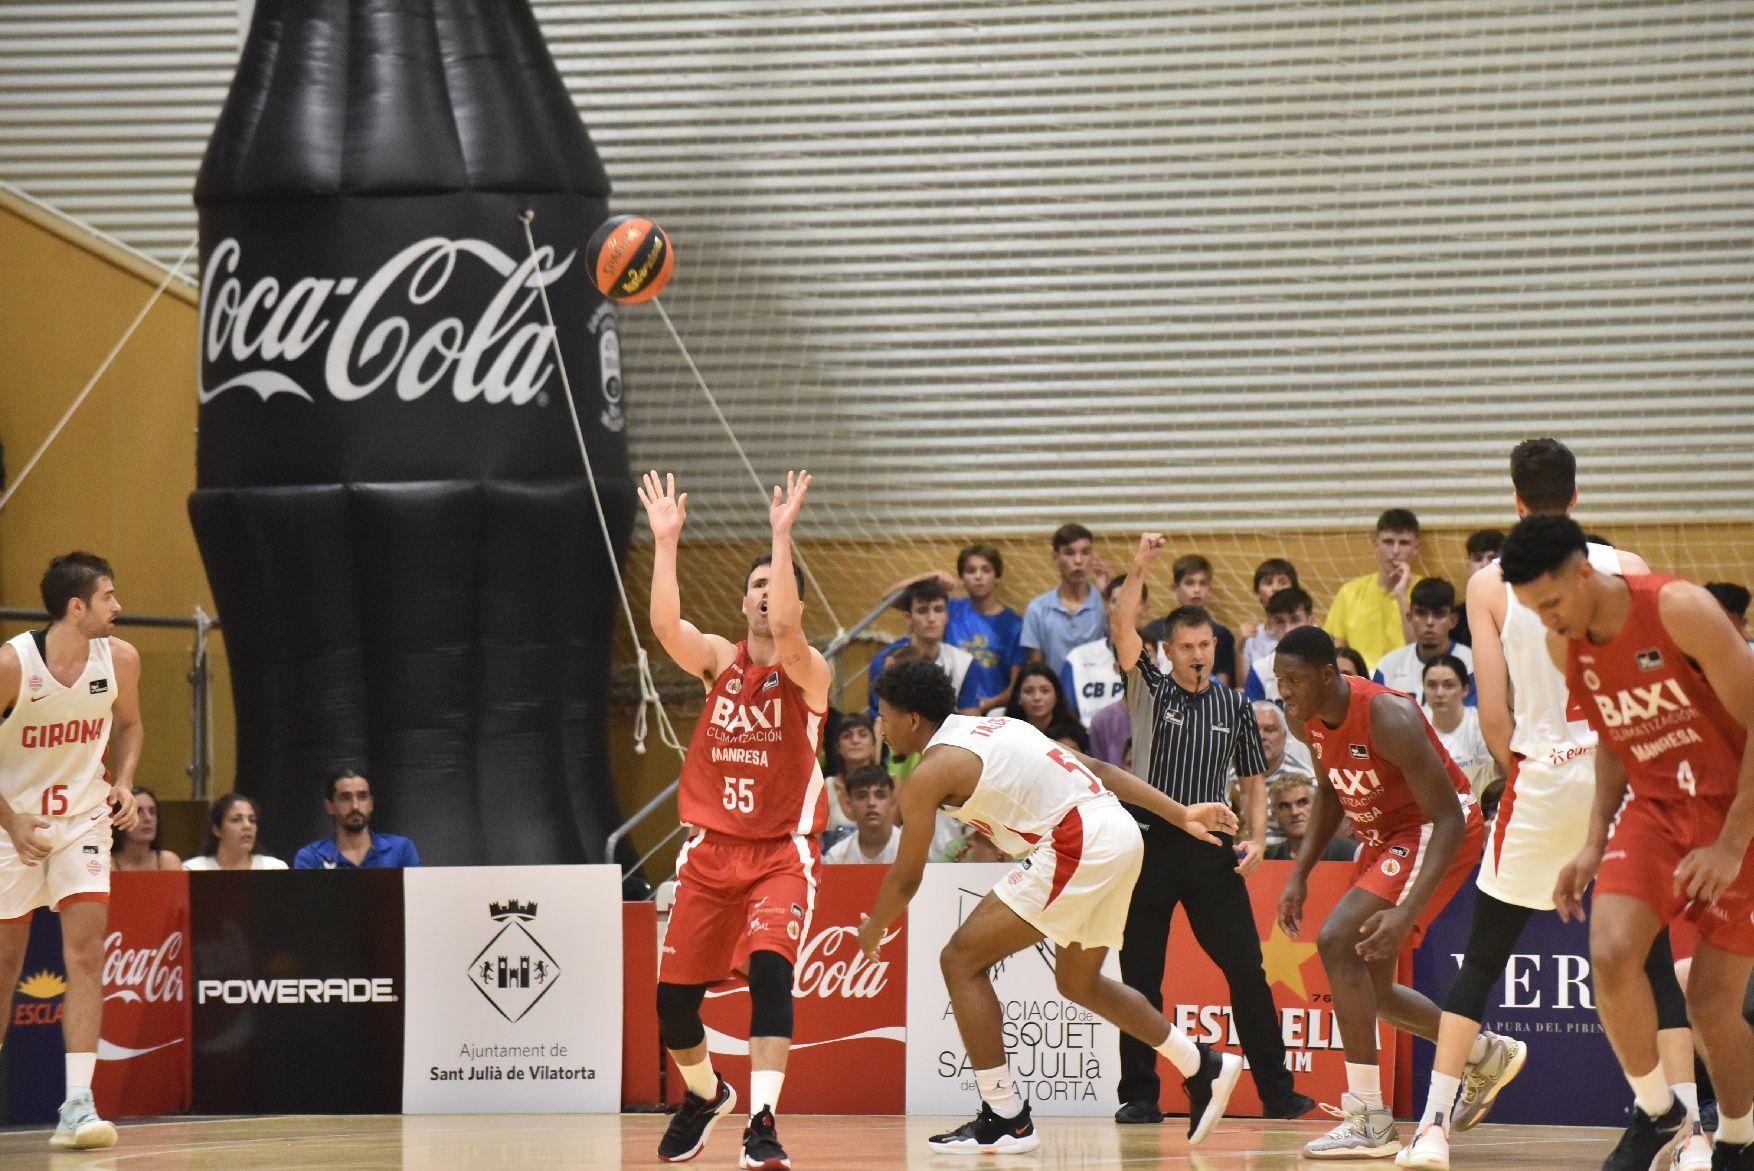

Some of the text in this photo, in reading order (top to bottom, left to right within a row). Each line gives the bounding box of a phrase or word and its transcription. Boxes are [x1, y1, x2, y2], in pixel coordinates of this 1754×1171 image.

[199, 236, 577, 406] Coca-Cola
[1082, 682, 1105, 698] CB
[1593, 678, 1691, 727] BAXI
[710, 695, 782, 733] BAXI
[21, 717, 104, 749] GIRONA
[706, 726, 783, 744] CLIMATIZACIÓN
[1630, 727, 1703, 763] MANRESA
[711, 747, 769, 768] MANRESA
[1328, 767, 1381, 796] AXI
[1677, 760, 1697, 797] 4
[41, 784, 68, 816] 15
[722, 776, 755, 814] 55
[101, 931, 184, 1002] Coca-Co
[199, 978, 394, 1004] POWERADE
[1312, 993, 1332, 1002] 76
[15, 1002, 65, 1025] ESCLA
[1078, 1010, 1093, 1021] de
[1495, 1022, 1531, 1032] PURA
[1535, 1023, 1562, 1032] DEL
[1566, 1023, 1604, 1033] PIRIN
[1001, 1021, 1102, 1049] SQUET
[460, 1043, 568, 1061] Ajuntament de
[938, 1050, 1018, 1078] SAT
[430, 1065, 596, 1081] Sant Julià de Vilatorta
[960, 1080, 1098, 1101] de ATORTA
